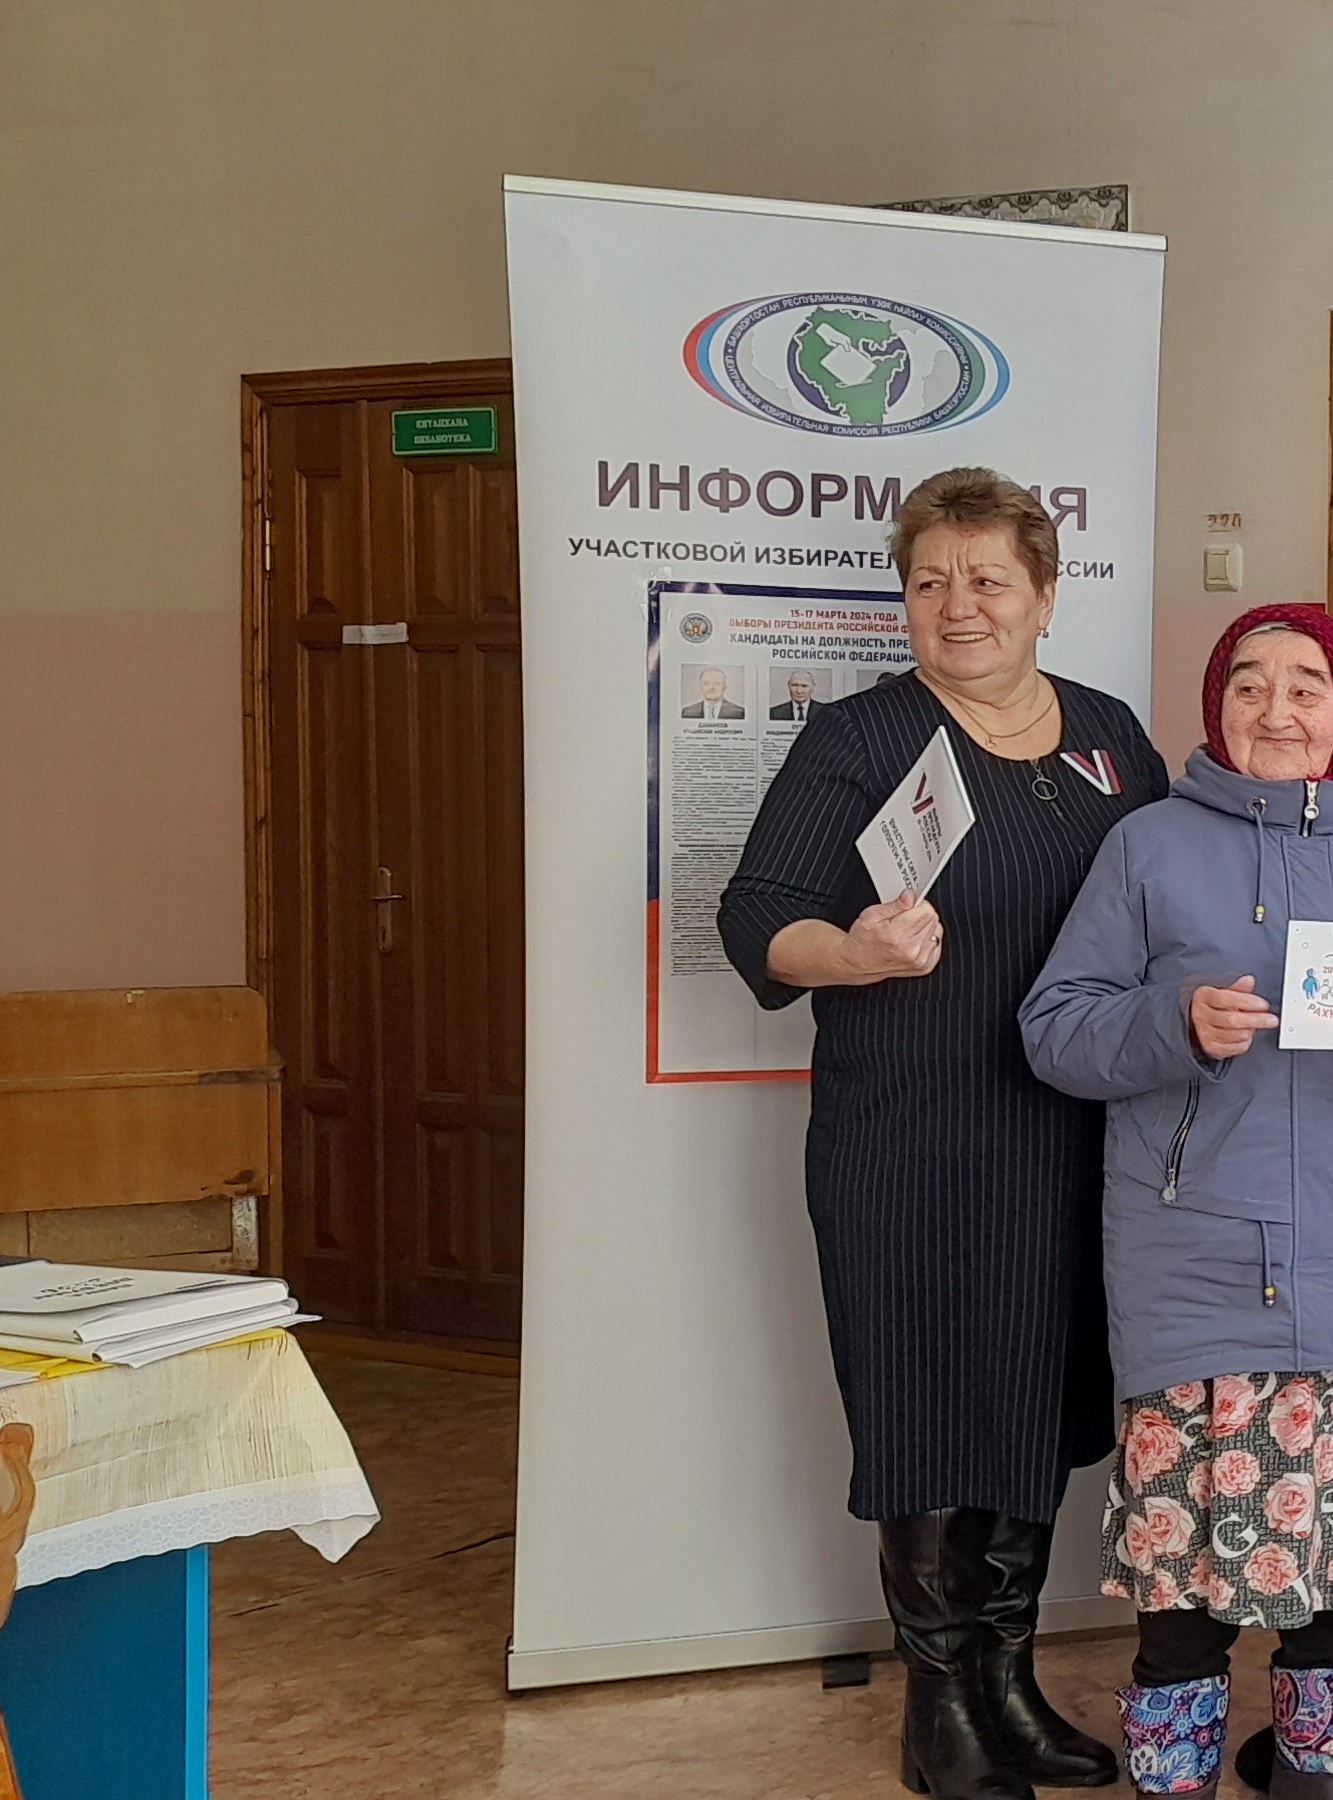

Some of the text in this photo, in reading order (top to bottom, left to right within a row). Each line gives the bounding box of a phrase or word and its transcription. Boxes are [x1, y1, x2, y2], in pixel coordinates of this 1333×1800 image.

[598, 460, 1087, 532] ИНФОРМЯ
[568, 537, 746, 564] УЧАСТКОВОЙ
[790, 609, 898, 622] 15-17 МАРТА 2024 ГОДА
[729, 618, 771, 629] ВЫБОРЫ
[774, 620, 834, 631] ПРЕЗИДЕНТА
[837, 621, 899, 633] РОССИЙСКОЙ
[730, 633, 799, 646] КАНДИДАТЫ
[801, 637, 815, 646] НА
[818, 636, 886, 649] ДОЛЖНОСТЬ
[772, 648, 846, 661] РОССИЙСКОЙ
